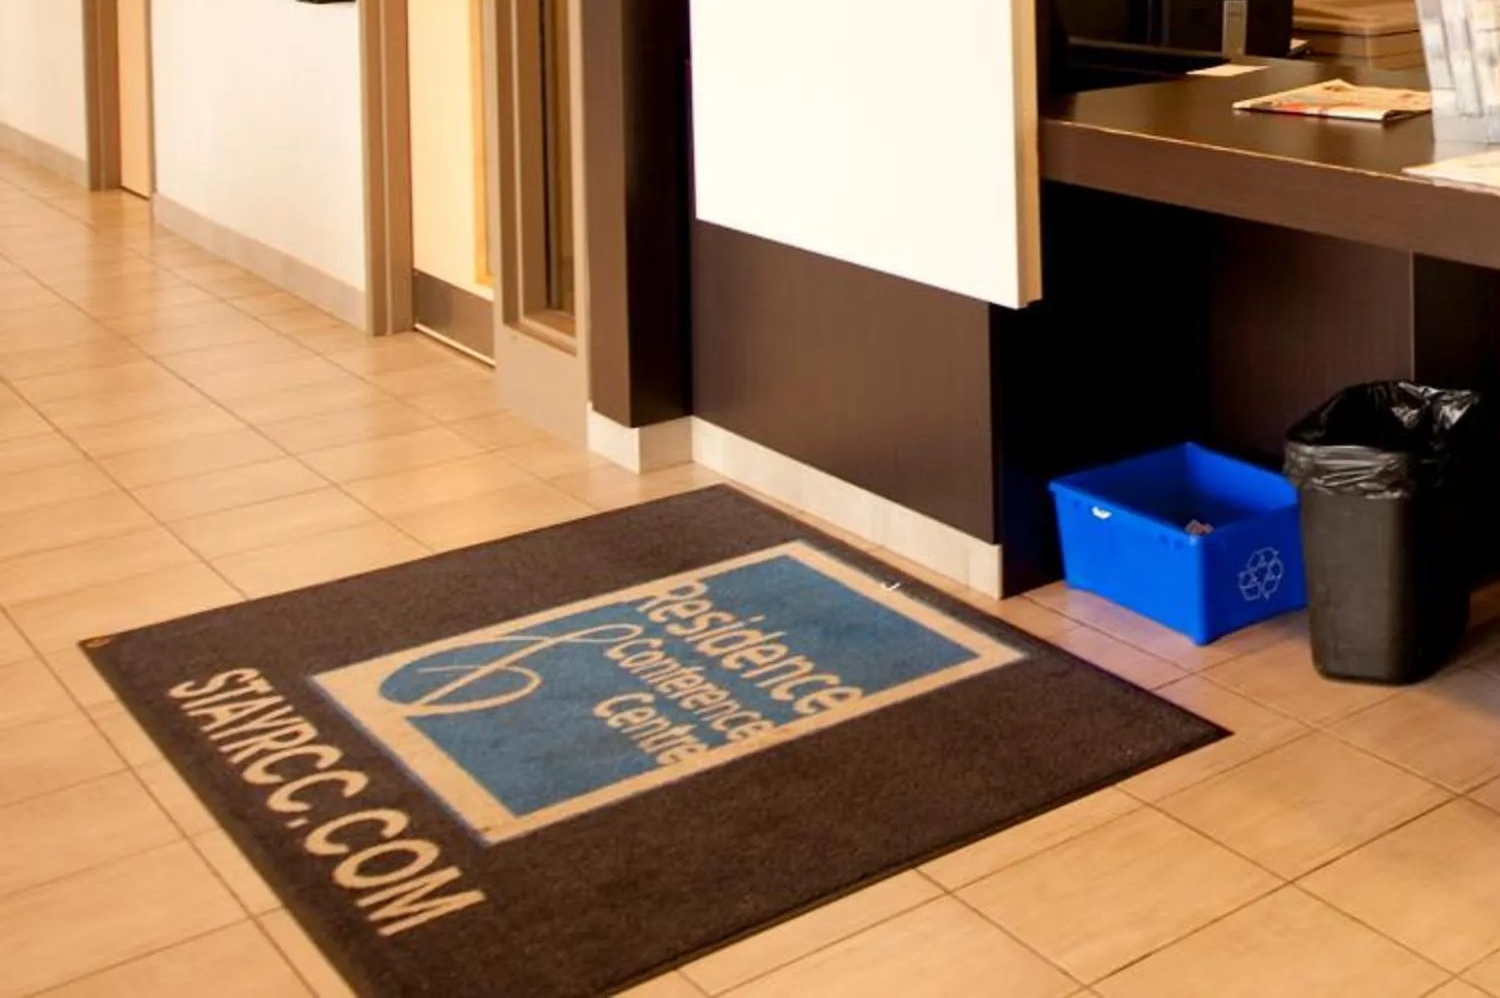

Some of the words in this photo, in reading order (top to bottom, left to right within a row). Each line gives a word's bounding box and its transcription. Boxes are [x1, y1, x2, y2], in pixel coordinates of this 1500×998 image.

[604, 638, 776, 743] Conference
[634, 580, 864, 715] Residence
[592, 692, 709, 766] Centre
[167, 667, 487, 938] STAYRCC.COM
